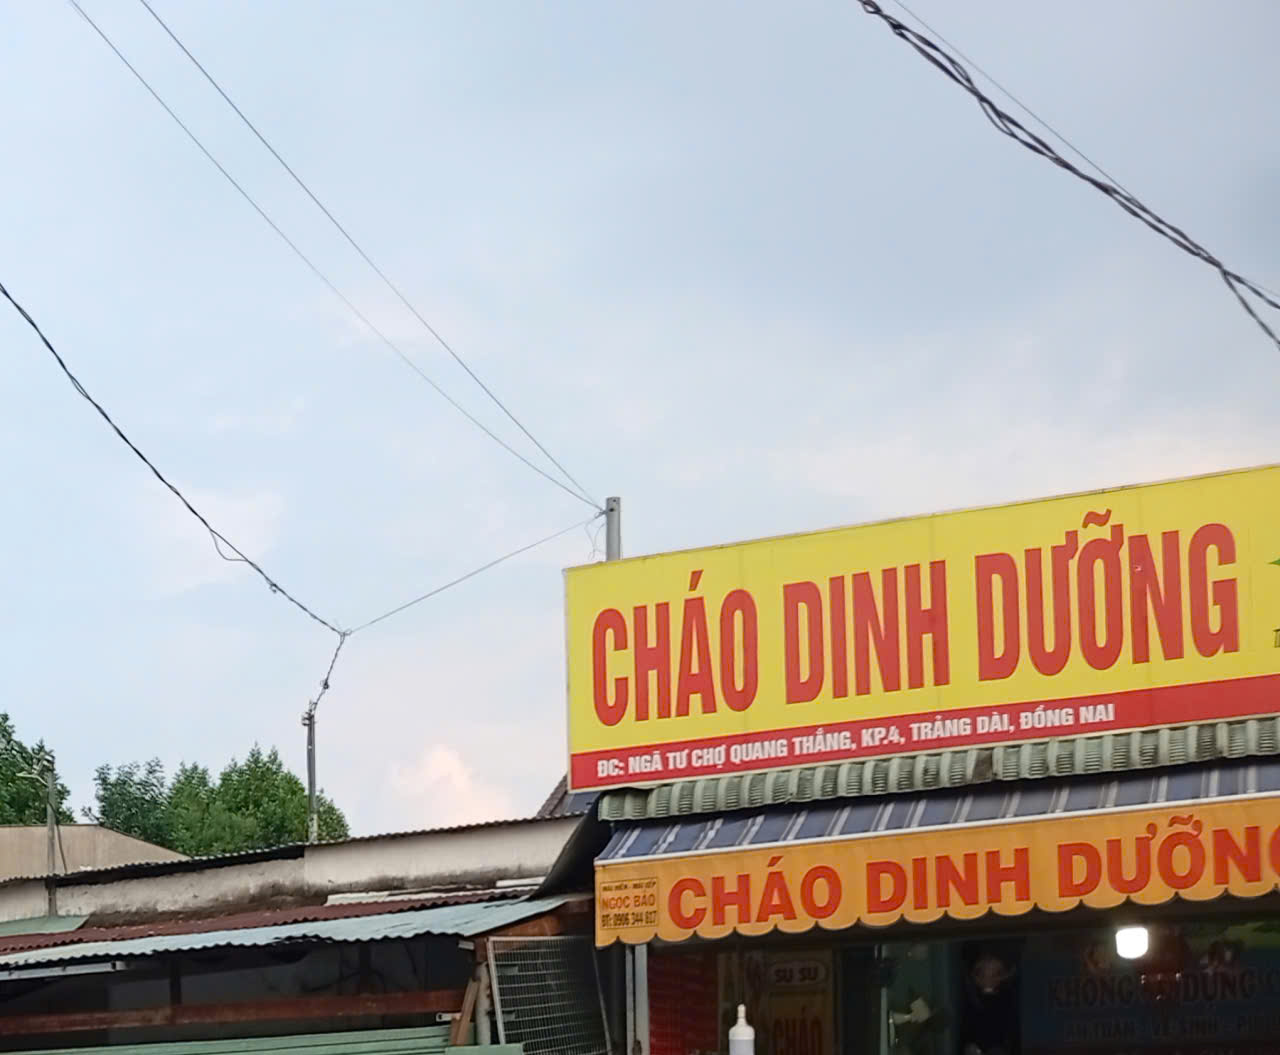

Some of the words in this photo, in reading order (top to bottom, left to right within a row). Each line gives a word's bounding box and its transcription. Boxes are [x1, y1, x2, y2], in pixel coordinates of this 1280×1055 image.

[591, 570, 759, 727] CHÁO
[783, 559, 949, 705] DINH
[974, 509, 1240, 682] DƯỠNG
[628, 750, 662, 774] NGÃ
[666, 748, 689, 769] TƯ
[691, 745, 726, 768] CHỢ
[730, 739, 788, 764] QUANG
[909, 715, 972, 742] TRẢNG
[976, 712, 1015, 734] DÀI,
[1079, 703, 1116, 723] NAI
[667, 856, 842, 931] CHÁO
[865, 846, 1032, 914] DINH
[1057, 814, 1280, 898] DƯỠN
